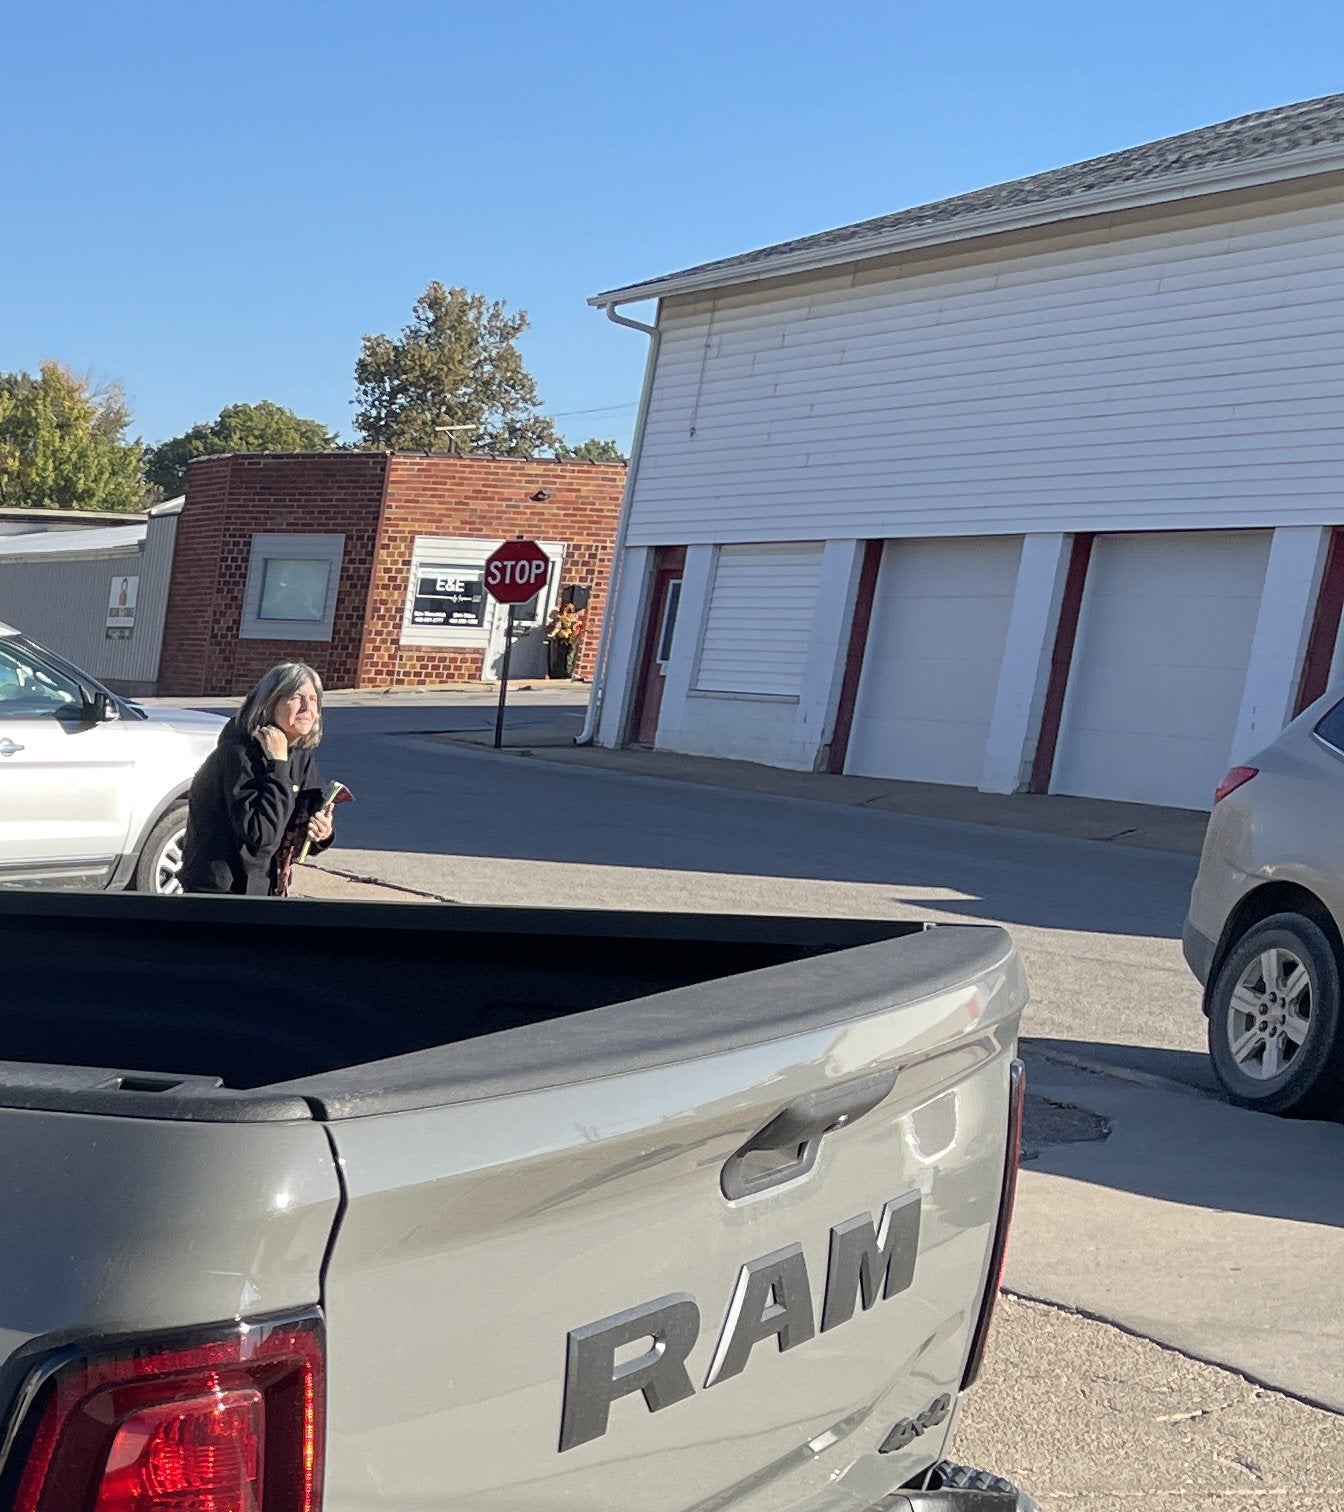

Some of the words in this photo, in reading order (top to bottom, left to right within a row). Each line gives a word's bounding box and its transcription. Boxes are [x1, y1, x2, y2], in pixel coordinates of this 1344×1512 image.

[435, 576, 465, 592] E&E
[487, 560, 545, 584] STOP
[558, 1188, 922, 1453] RAM
